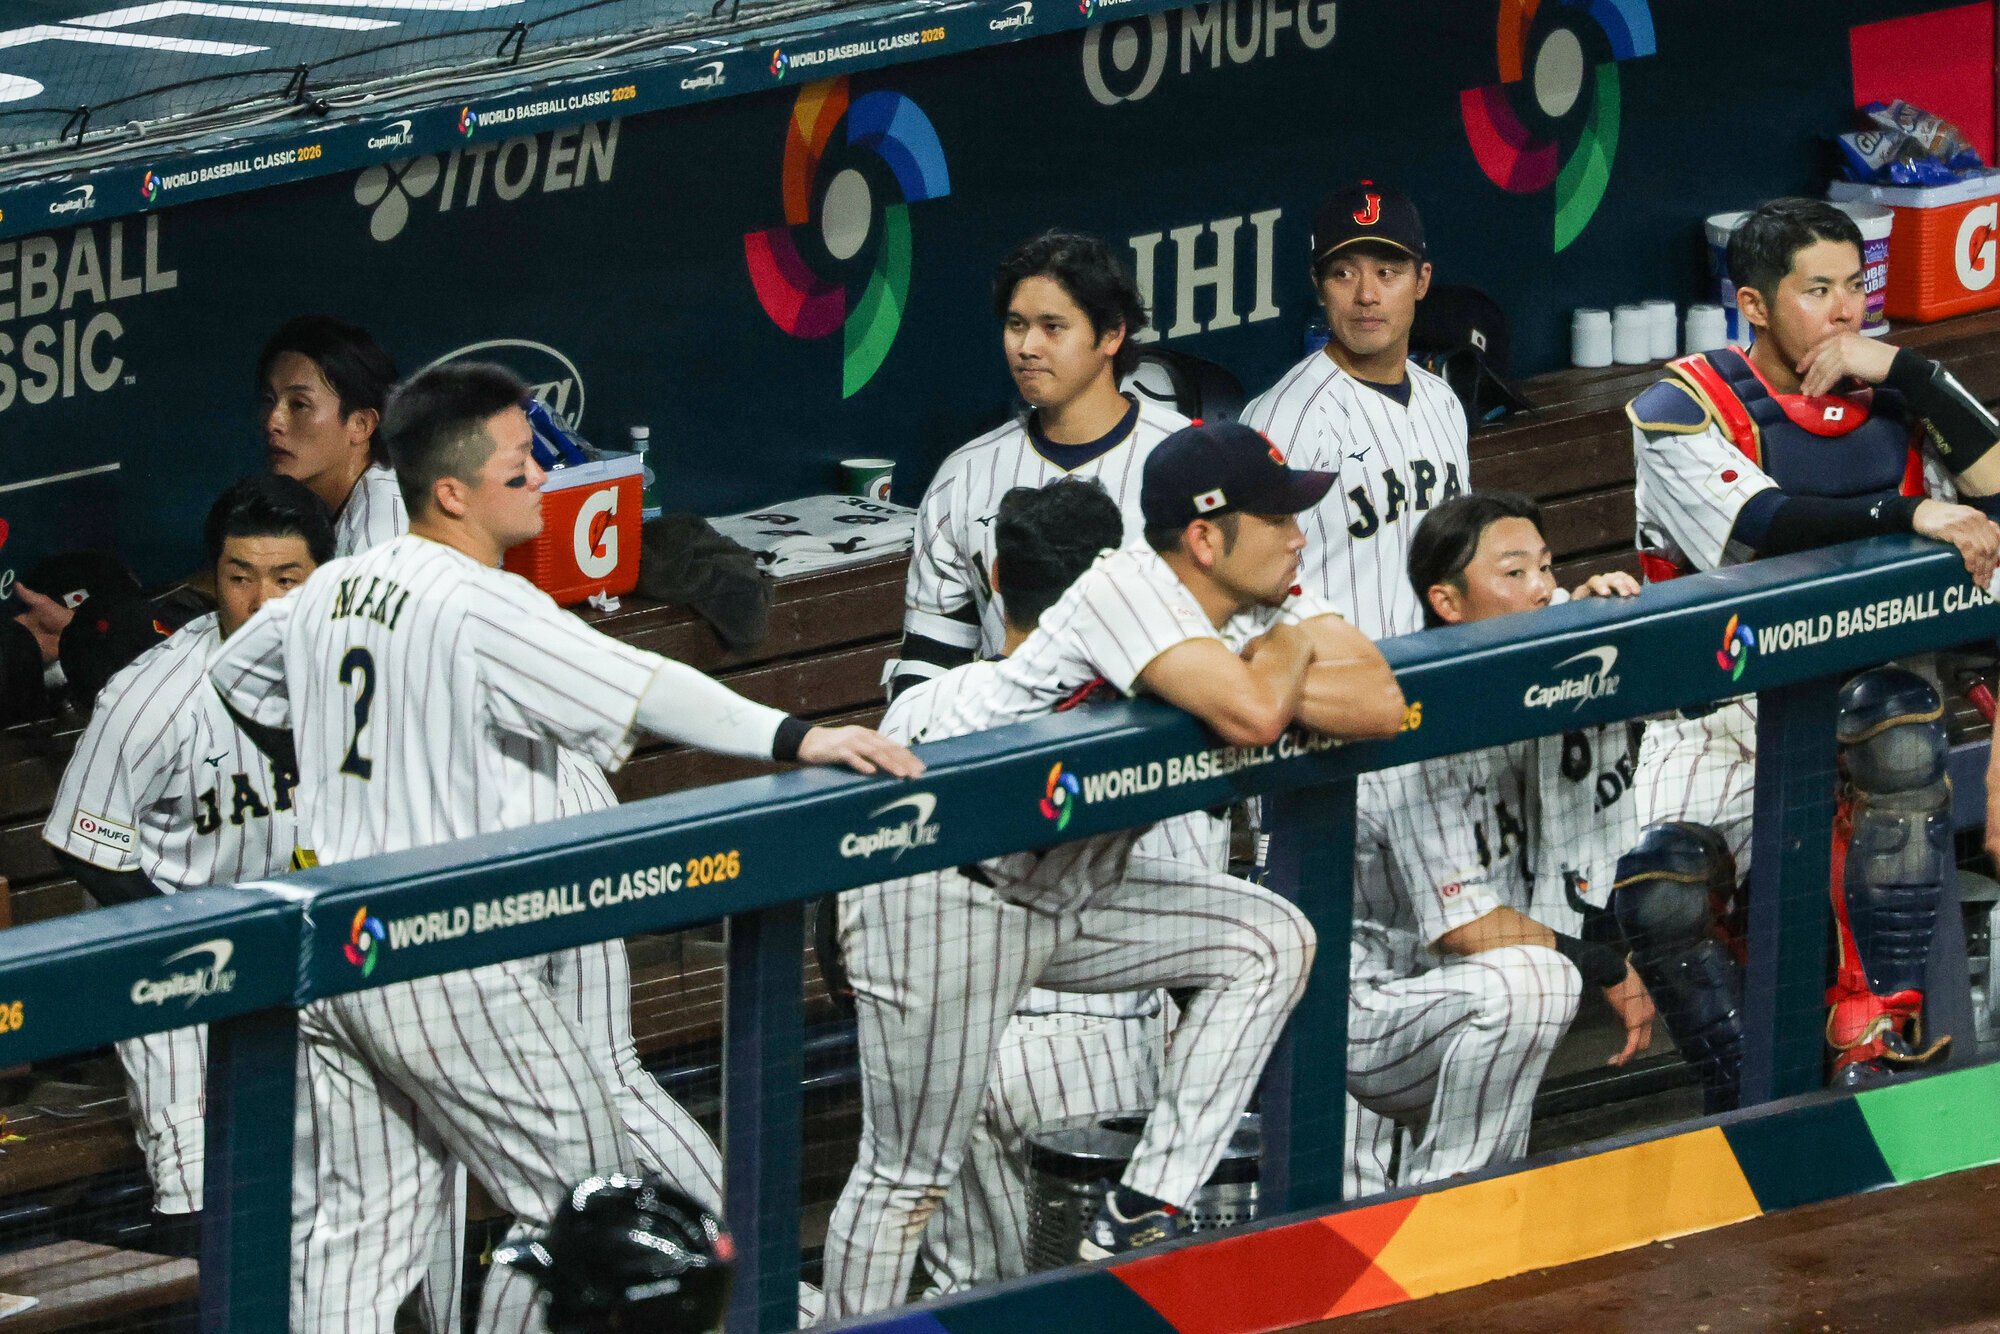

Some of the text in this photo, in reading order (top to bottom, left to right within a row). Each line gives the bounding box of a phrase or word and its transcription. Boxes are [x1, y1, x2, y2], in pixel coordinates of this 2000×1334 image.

[790, 26, 945, 68] WORLD BASEBALL CLASSIC 2026
[1181, 1, 1336, 74] MUFG
[478, 85, 637, 127] WORLD BASEBALL CLASSIC 2026
[162, 144, 322, 190] WORLD BASEBALL CLASSIC 2026
[1353, 193, 1381, 225] J
[1129, 208, 1282, 345] IHI
[1955, 202, 1998, 291] G
[573, 485, 619, 579] G
[331, 576, 410, 631] MAKI
[1758, 615, 1832, 655] WORLD
[1836, 590, 1939, 638] BASEBALL
[338, 645, 376, 781] 2
[1083, 762, 1163, 804] WORLD
[97, 825, 131, 844] MUFG
[387, 849, 741, 951] WORLD BASEBALL CLASSIC 2026
